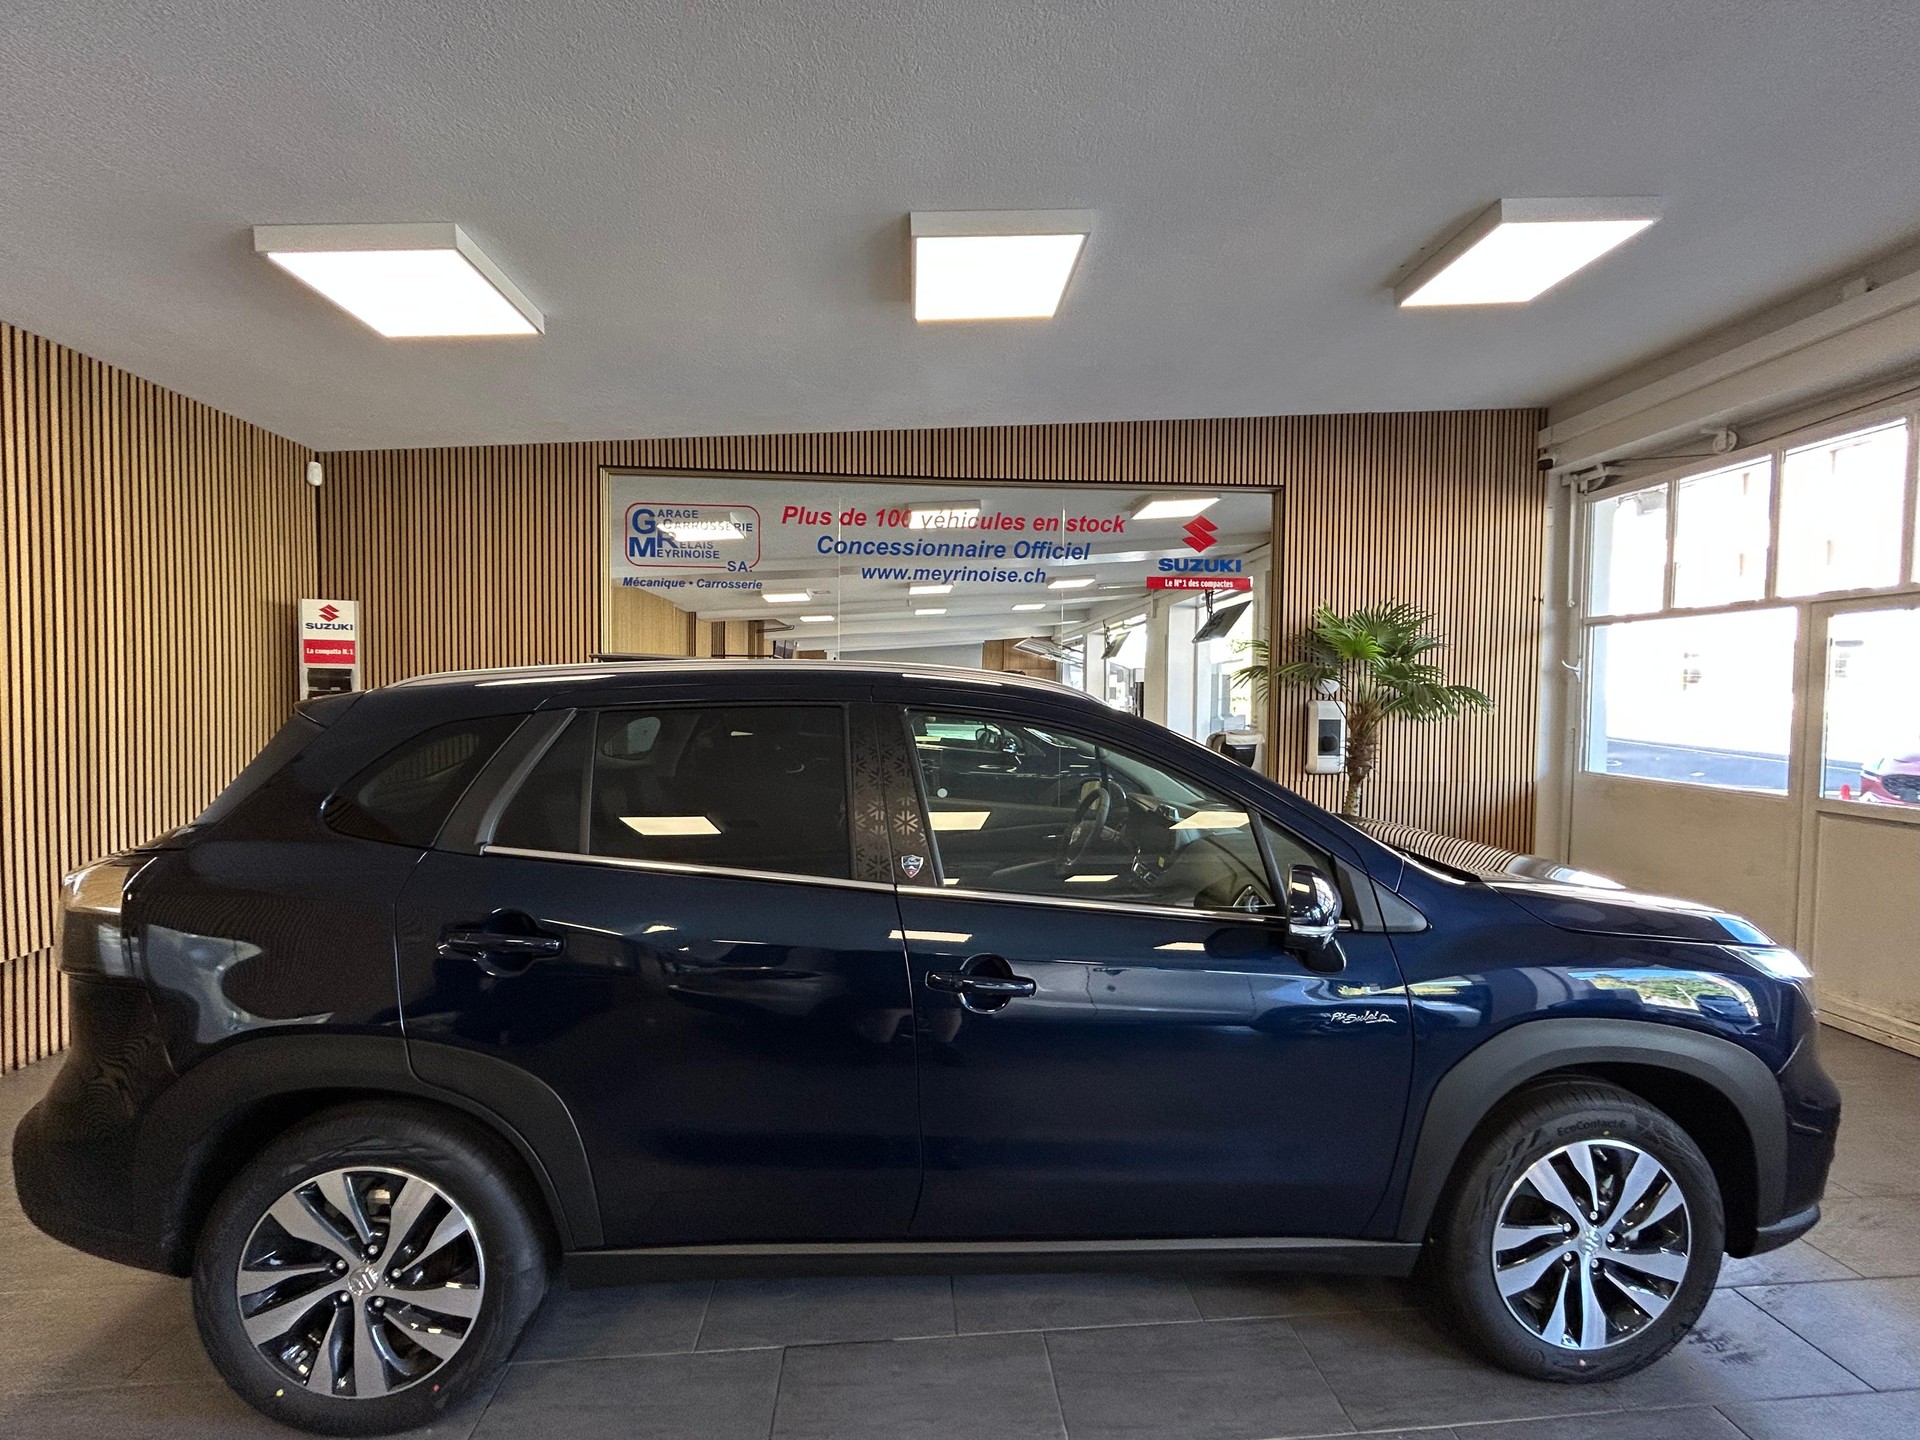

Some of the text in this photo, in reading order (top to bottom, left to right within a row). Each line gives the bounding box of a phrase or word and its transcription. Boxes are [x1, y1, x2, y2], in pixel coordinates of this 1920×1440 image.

[632, 509, 699, 534] GARAGE
[782, 506, 1126, 533] Plus de 100 véhicules en stock
[629, 537, 720, 558] MEYRINOISE
[817, 535, 1091, 560] Concessionnaire Officiel
[727, 560, 753, 572] SA.
[1158, 558, 1242, 573] SUZUKI
[623, 577, 763, 589] Mécanique Carrosserie
[861, 567, 1046, 585] www.meyrinoise.ch
[1165, 579, 1173, 587] Le
[1188, 579, 1199, 587] des
[1200, 580, 1233, 588] compactes
[305, 622, 354, 631] SUZUKI
[1557, 1119, 1618, 1137] EcoContact
